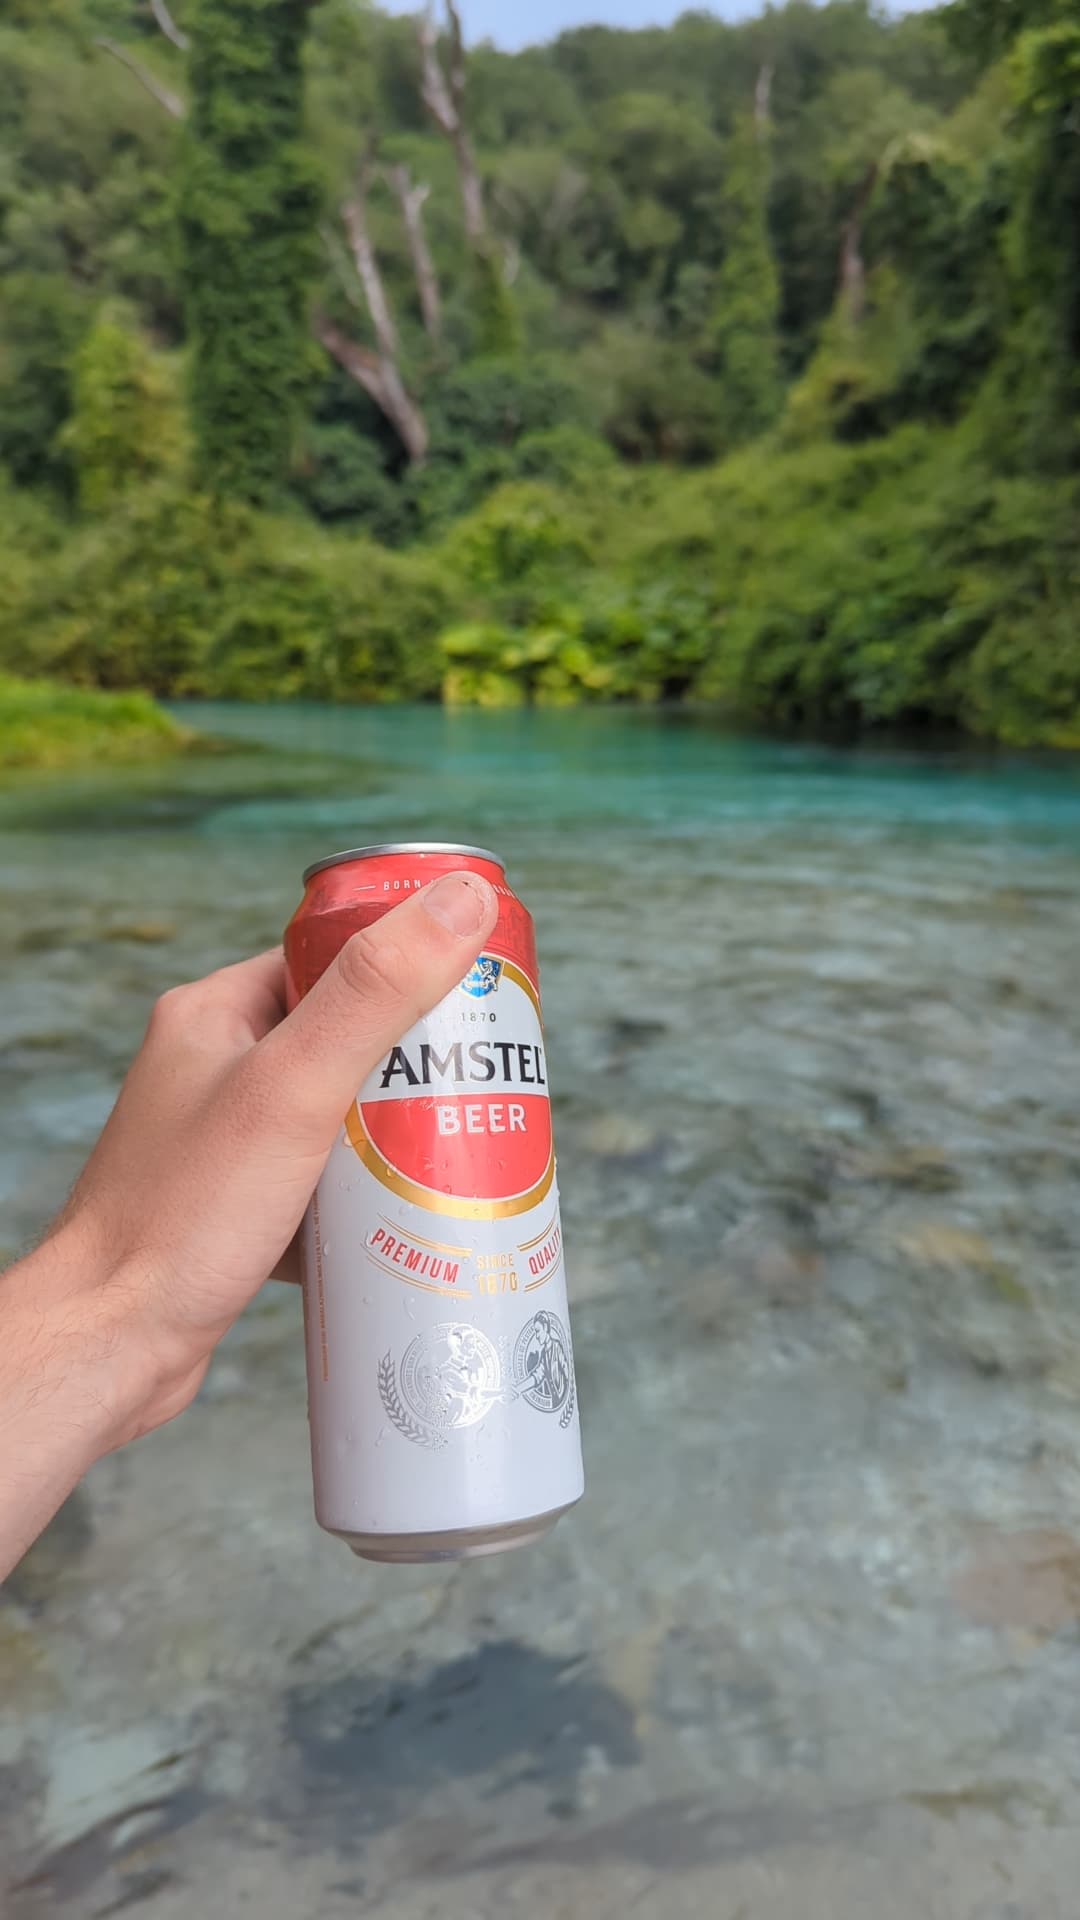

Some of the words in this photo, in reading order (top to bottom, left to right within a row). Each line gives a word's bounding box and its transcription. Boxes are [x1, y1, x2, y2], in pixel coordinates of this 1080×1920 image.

[383, 879, 422, 891] BORN
[461, 1012, 497, 1023] 1870
[379, 1041, 546, 1088] AMSTEL
[436, 1103, 527, 1136] BEER
[370, 1228, 460, 1284] PREMIUM
[476, 1253, 515, 1270] SINCE
[476, 1271, 519, 1295] 1870
